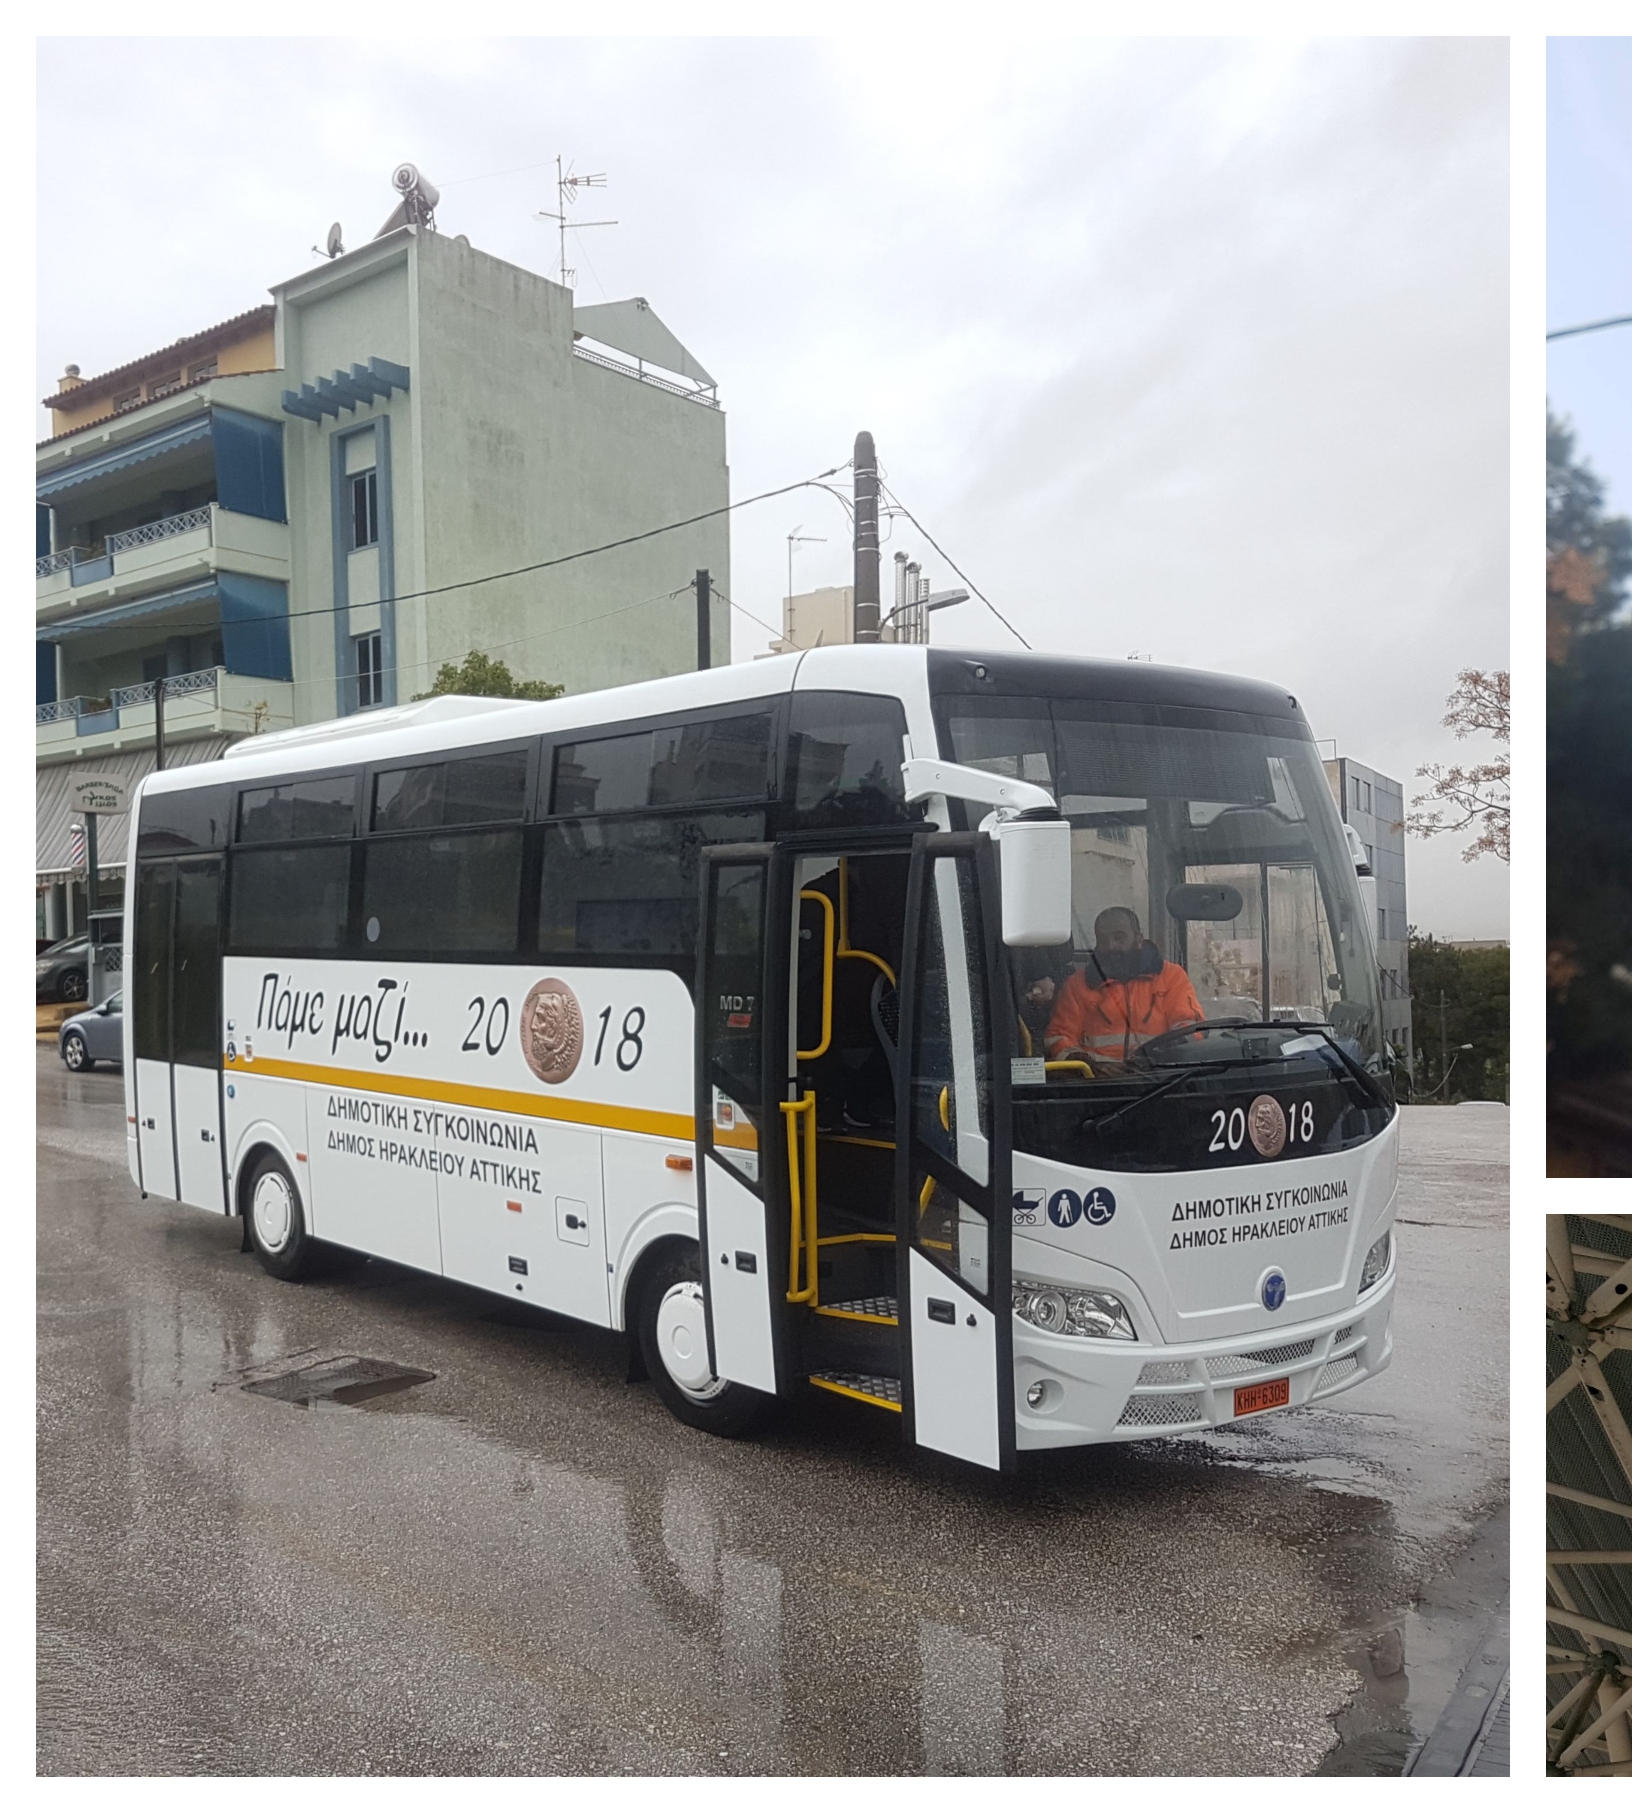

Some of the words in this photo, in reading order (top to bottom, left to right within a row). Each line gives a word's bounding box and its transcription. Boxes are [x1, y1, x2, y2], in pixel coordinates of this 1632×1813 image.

[257, 973, 324, 1050] Πάμε
[331, 976, 429, 1063] μαζί...
[461, 996, 510, 1054] 20
[594, 1005, 646, 1072] 18
[720, 995, 743, 1010] MD
[326, 1095, 409, 1131] ΔΗΜΟΤΙΚΗ
[413, 1111, 540, 1155] ΣΥΓΚΟΙΝΩΝΙΑ
[1208, 1108, 1246, 1152] 20
[1288, 1100, 1315, 1143] 18
[327, 1129, 376, 1159] ΔΗΜΟΣ
[379, 1140, 465, 1179] ΗΡΑΚΛΕΙΟΥ
[469, 1160, 542, 1194] ΑΤΤΙΚΗΣ
[1171, 1194, 1262, 1221] ΔΗΜΟΤΙΚΗ
[1266, 1179, 1349, 1211] ΣΥΓΚΟΙΝΩΝΙΑ
[1169, 1227, 1228, 1250] ΔΗΜΟΣ
[1232, 1215, 1305, 1243] ΗΡΑΚΛΕΙΟΥ
[1308, 1207, 1349, 1232] ΑΤΤΙΚΗΣ
